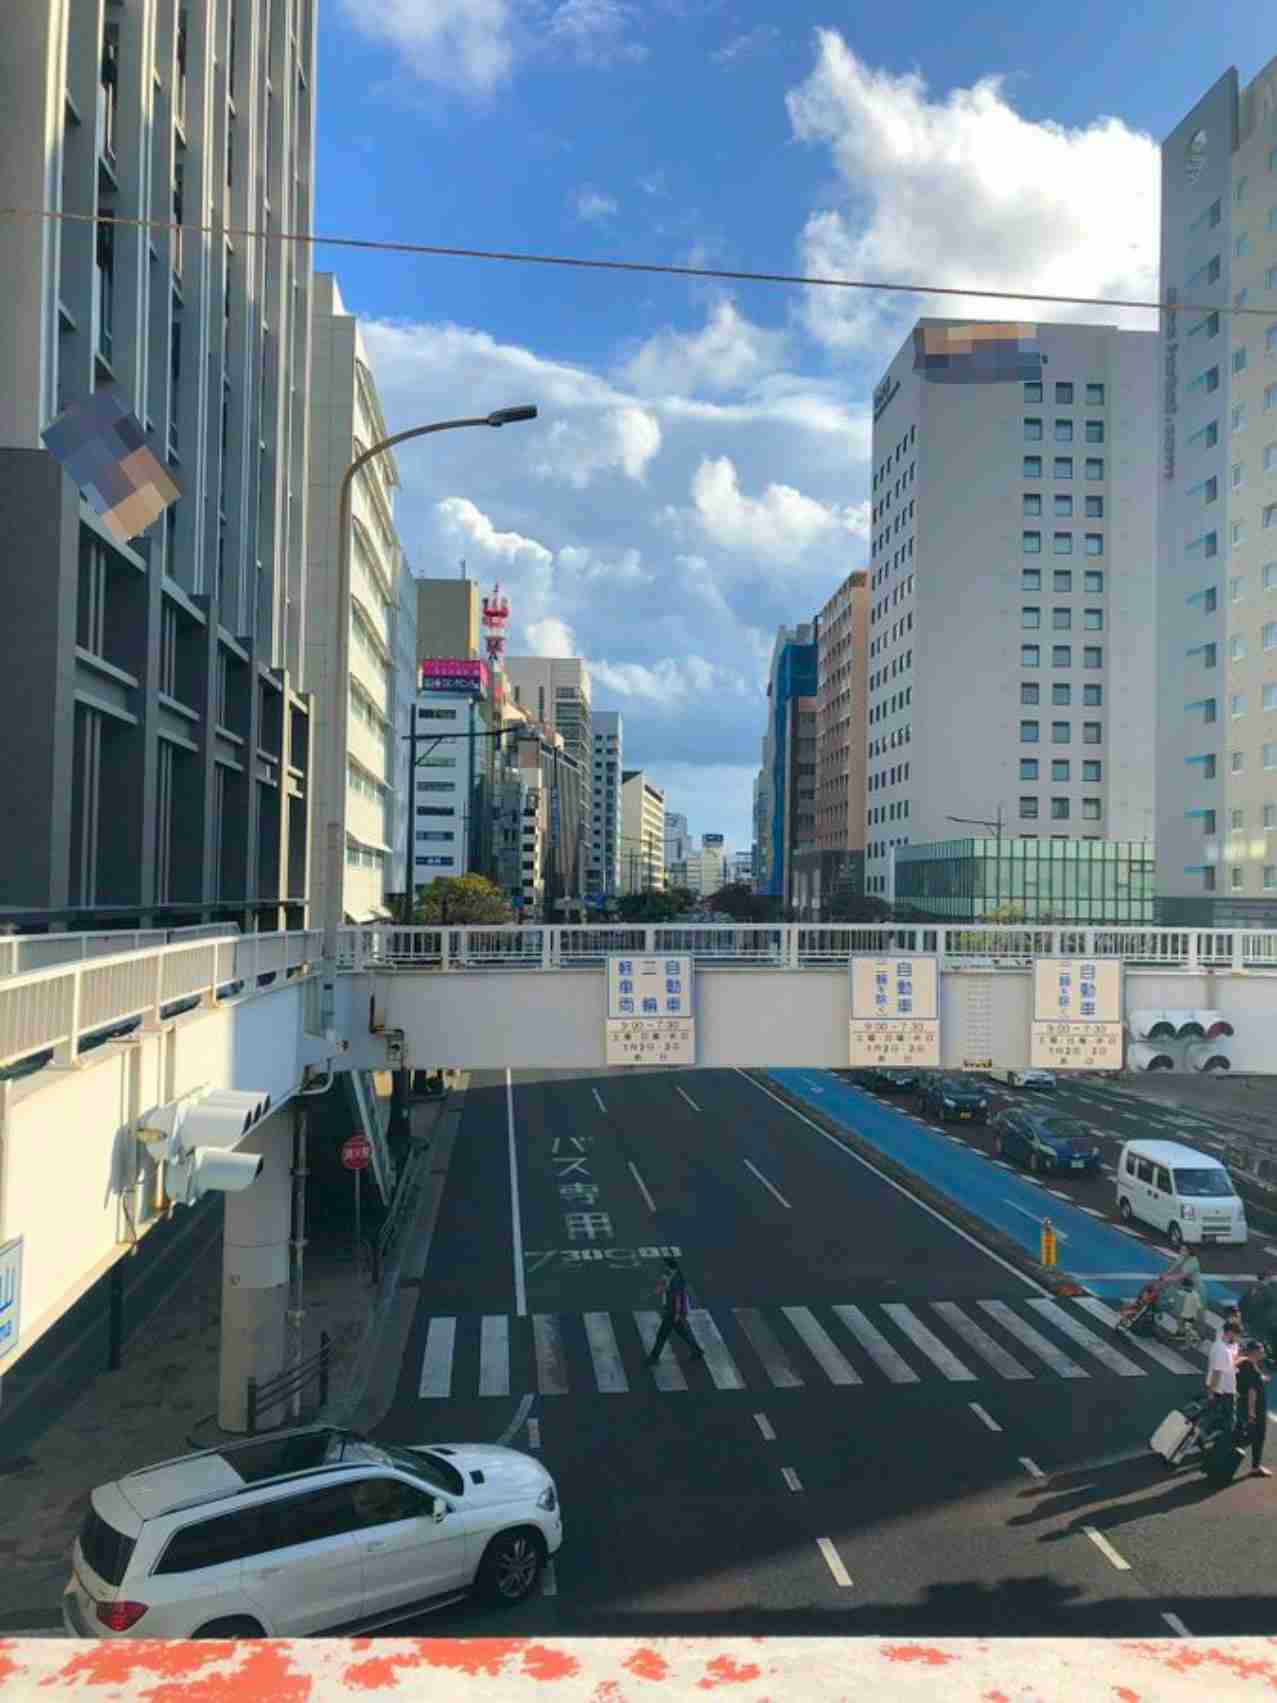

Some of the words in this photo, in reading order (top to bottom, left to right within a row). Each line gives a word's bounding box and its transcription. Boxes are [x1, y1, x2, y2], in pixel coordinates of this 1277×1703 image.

[641, 960, 657, 1013] 二輪
[665, 960, 681, 1010] 自動車
[897, 960, 913, 1013] 自動車
[1080, 963, 1097, 1016] 自動車
